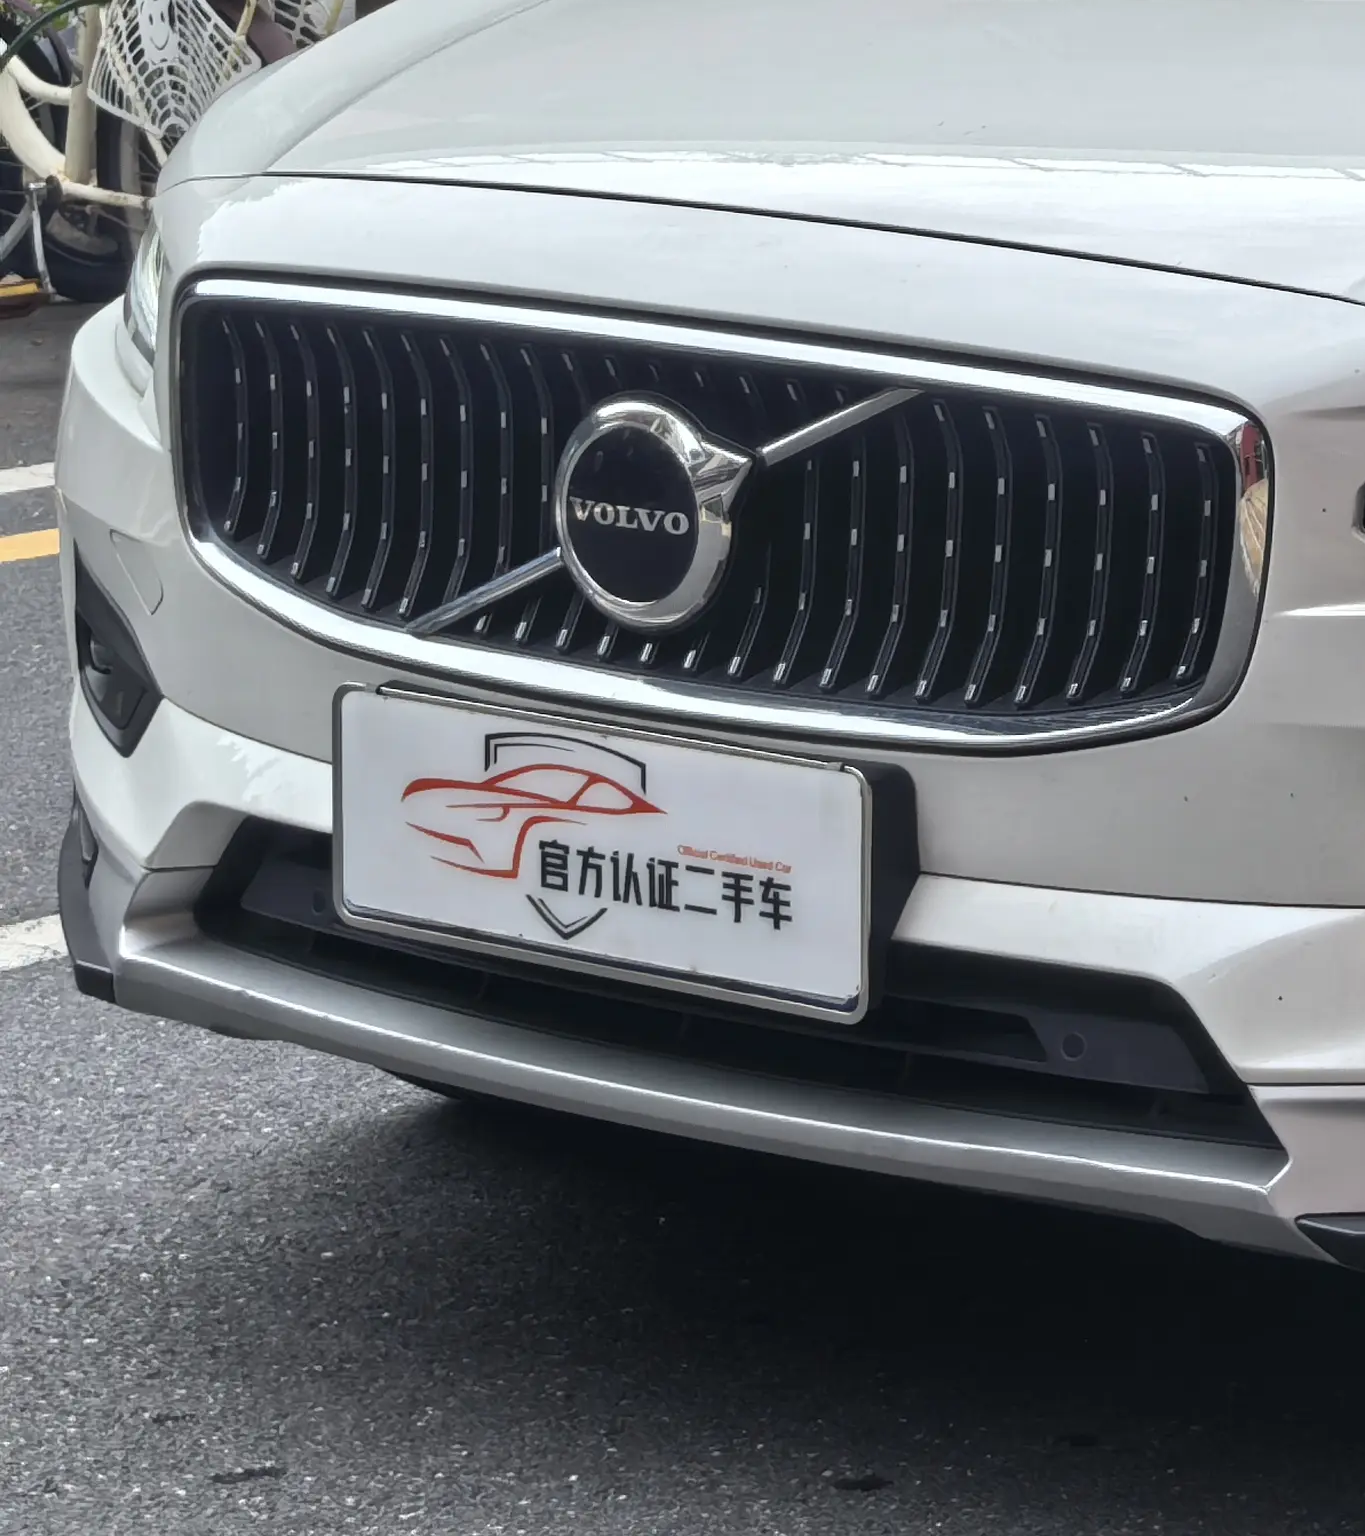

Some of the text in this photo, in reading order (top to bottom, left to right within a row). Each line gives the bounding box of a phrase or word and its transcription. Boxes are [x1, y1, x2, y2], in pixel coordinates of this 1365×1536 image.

[569, 496, 690, 535] VOLVO
[539, 839, 793, 931] 官方认证二手车
